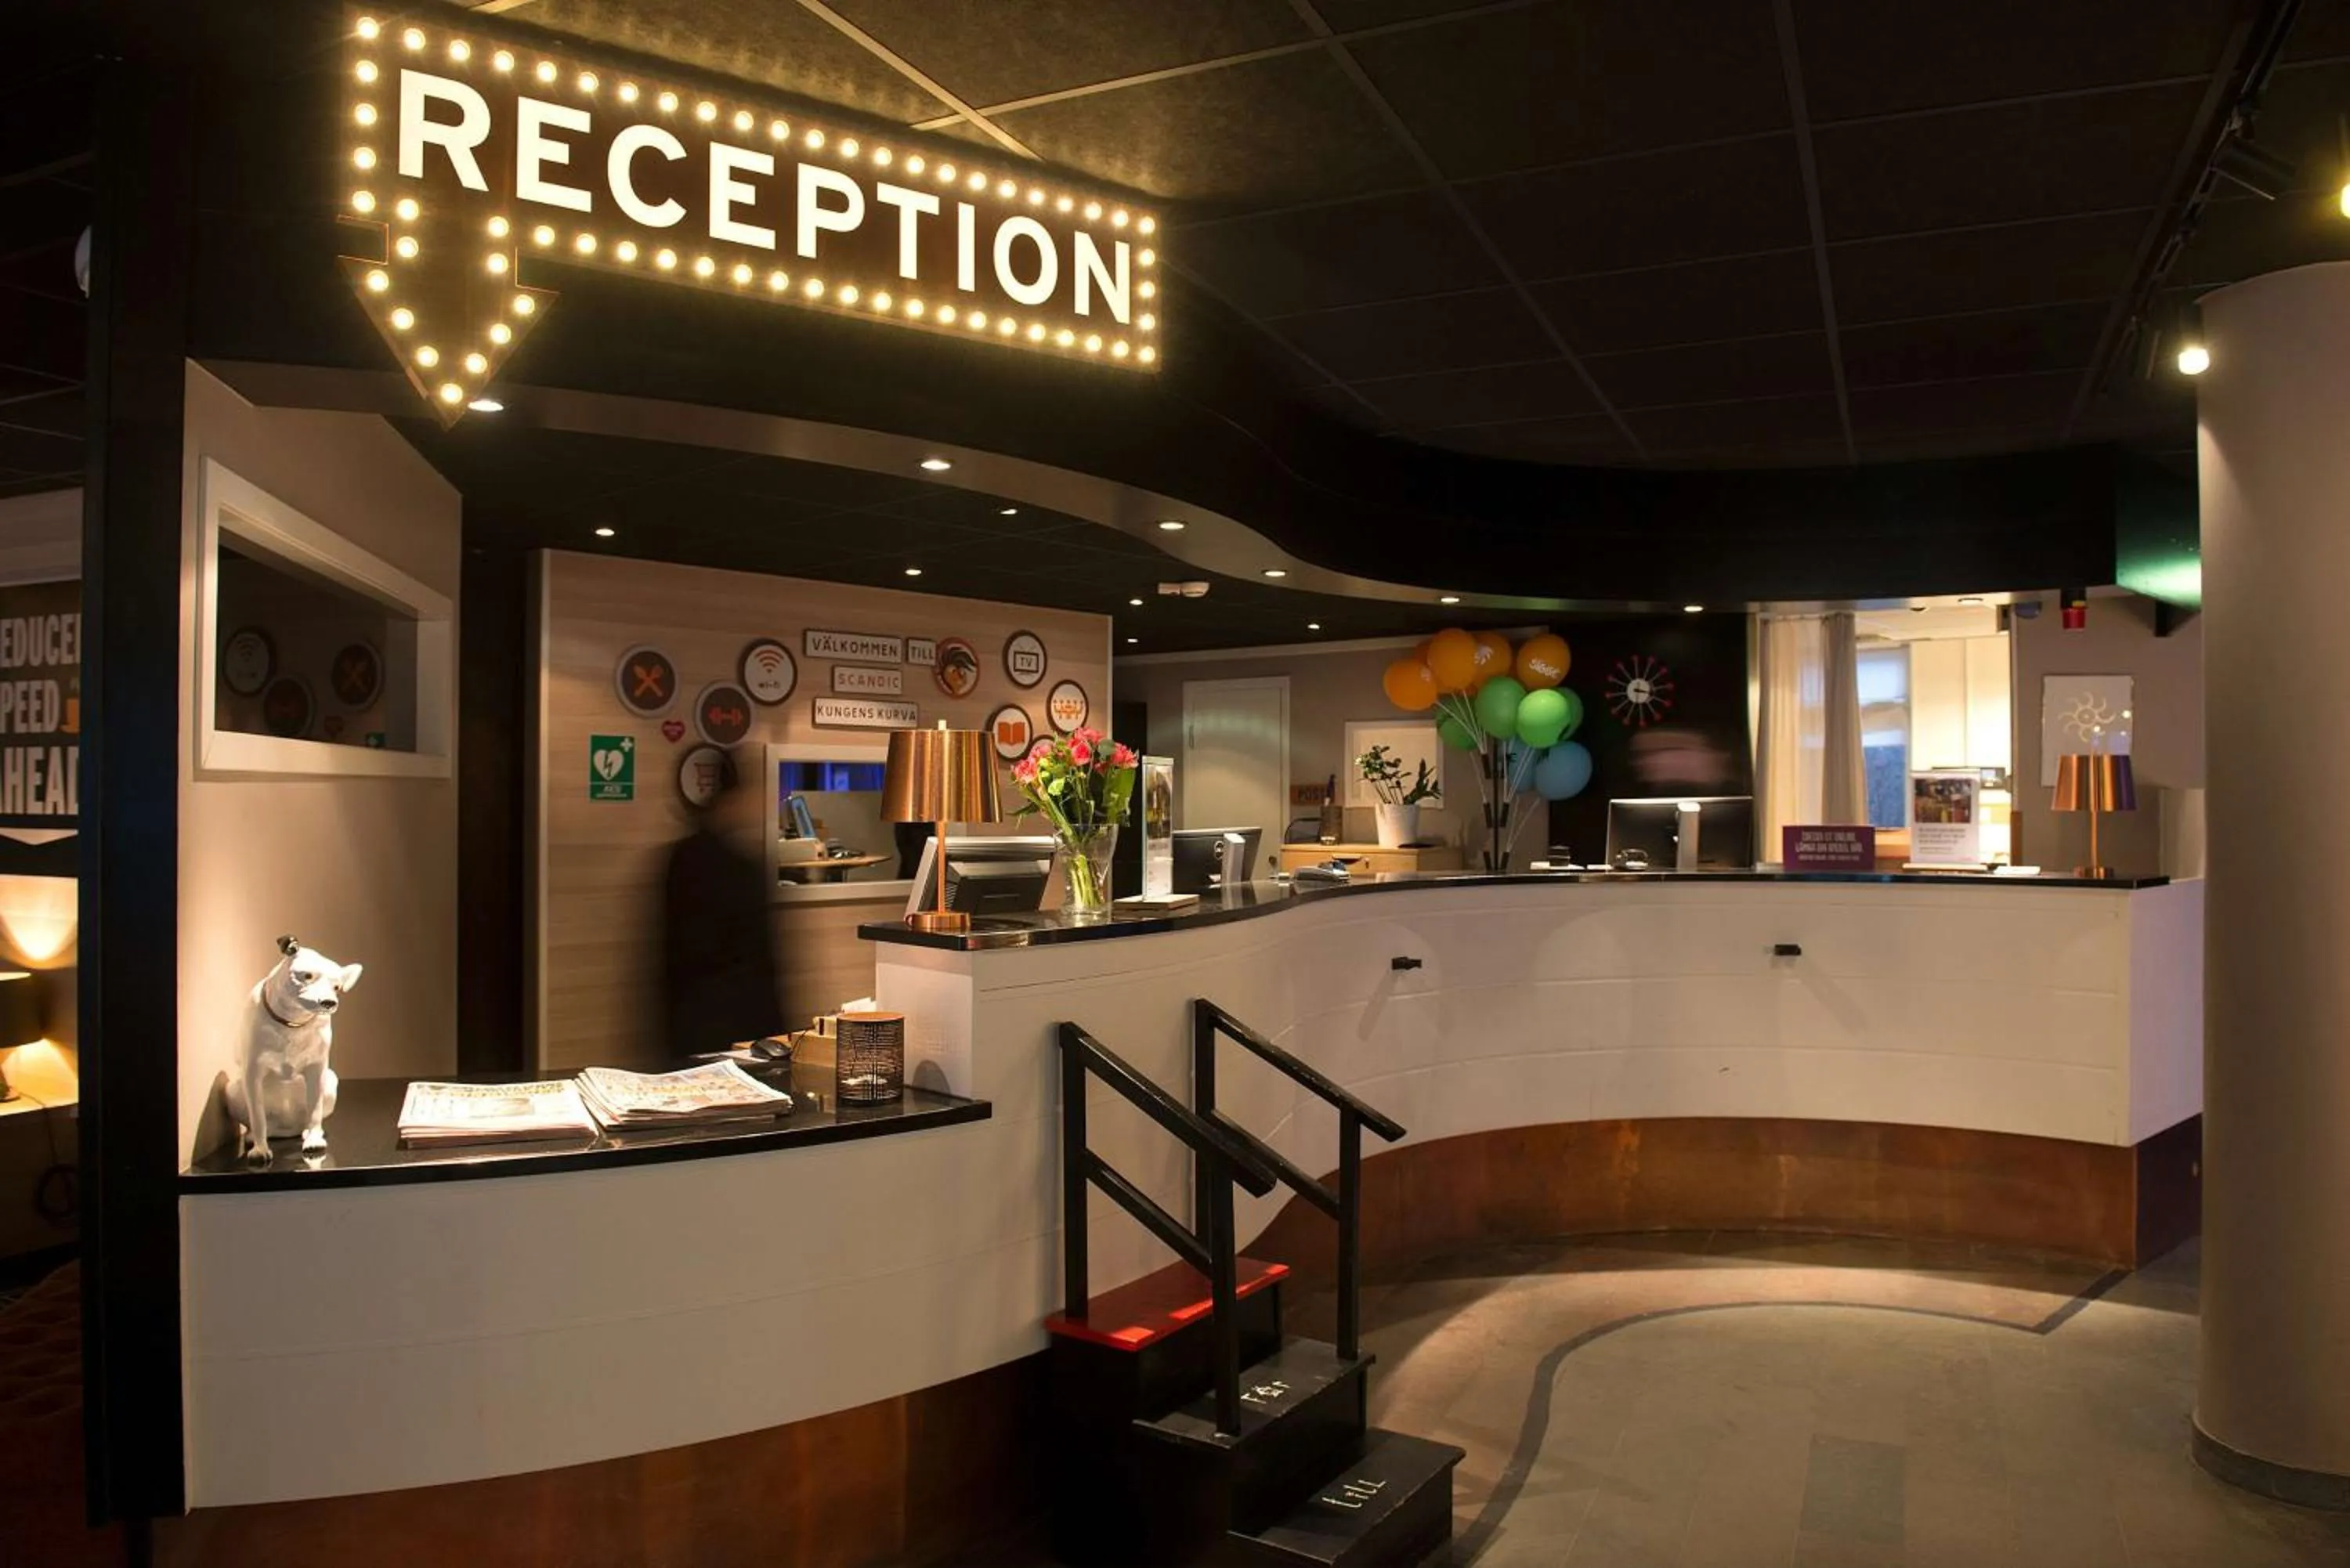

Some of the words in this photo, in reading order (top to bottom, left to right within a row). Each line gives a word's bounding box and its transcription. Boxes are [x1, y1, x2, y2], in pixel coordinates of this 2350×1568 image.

[398, 68, 1130, 324] RECEPTION
[812, 636, 898, 657] VÄLKOMMEN
[910, 645, 935, 660] TILL
[1021, 656, 1033, 668] TV
[837, 673, 900, 688] SCANDIC
[817, 706, 875, 719] KUNGENS
[877, 709, 916, 721] KURVA
[0, 746, 79, 815] HEA
